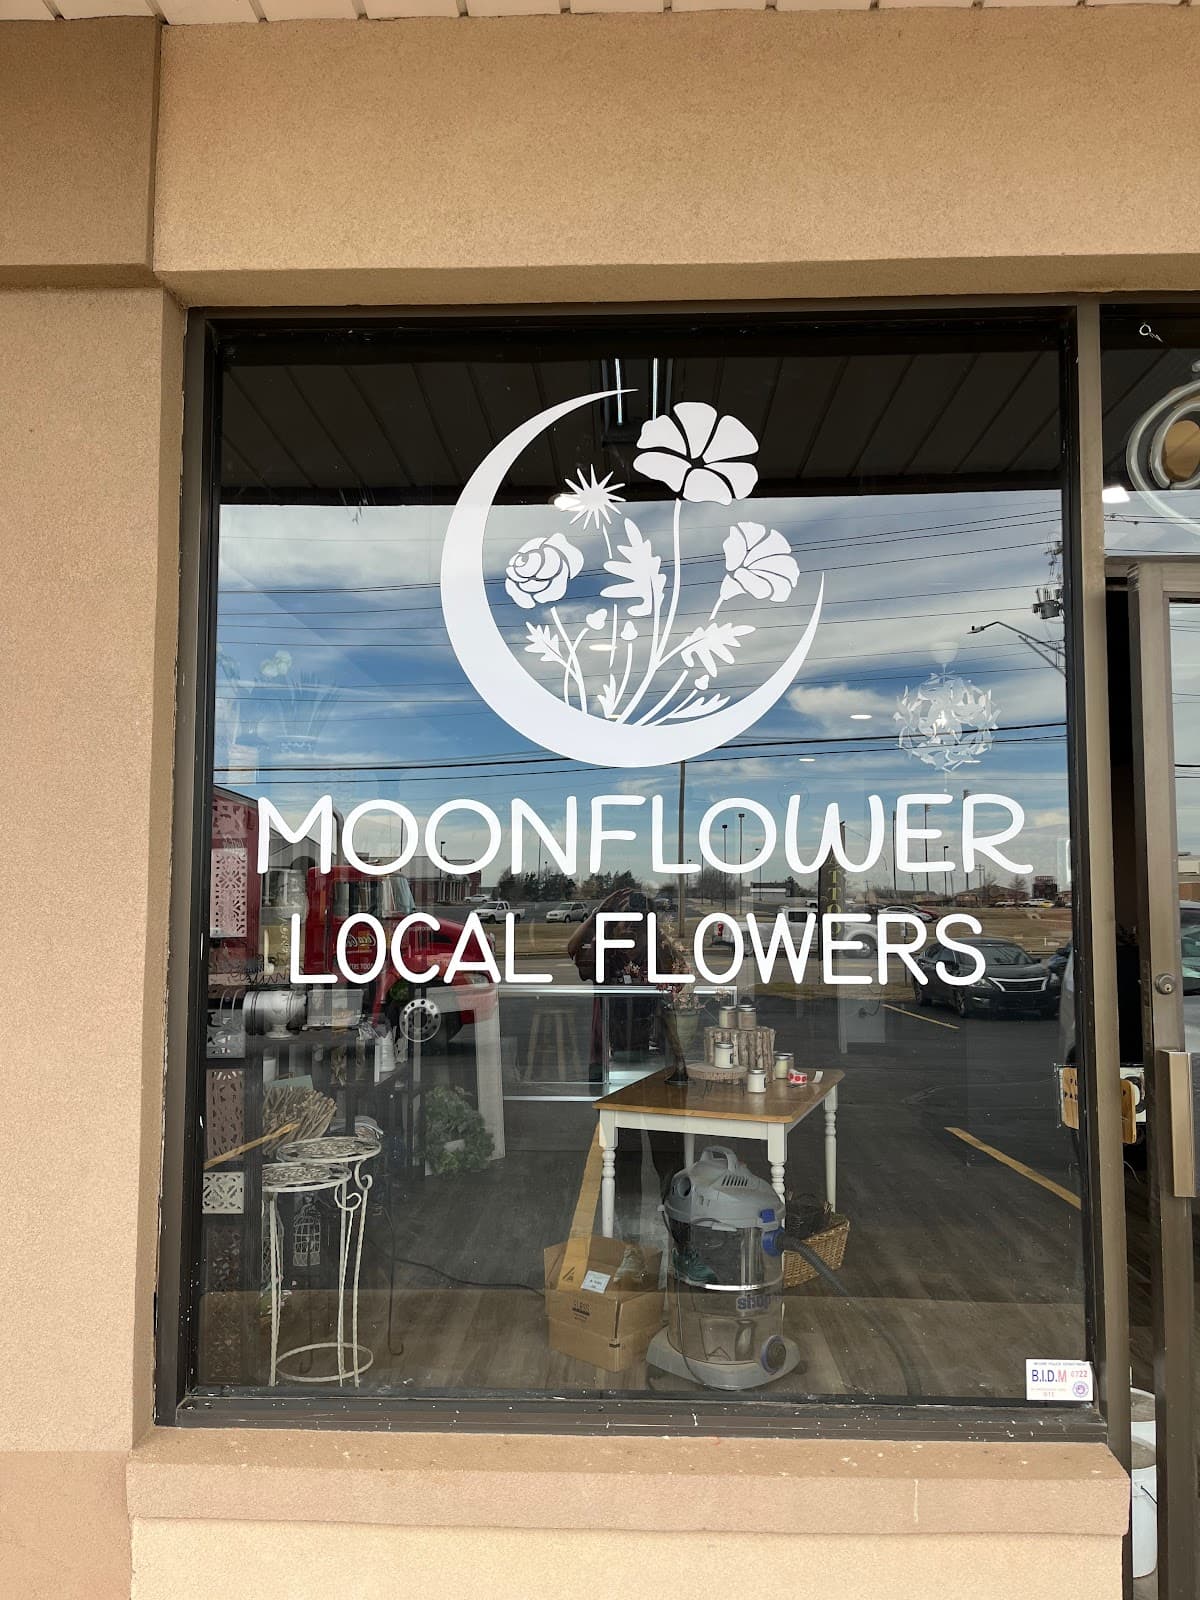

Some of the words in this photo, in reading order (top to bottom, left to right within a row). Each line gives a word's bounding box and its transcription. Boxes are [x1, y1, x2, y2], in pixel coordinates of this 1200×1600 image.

[256, 793, 1034, 876] MOONFLOWER
[290, 912, 553, 984] LOCAL
[595, 912, 986, 985] FLOWERS
